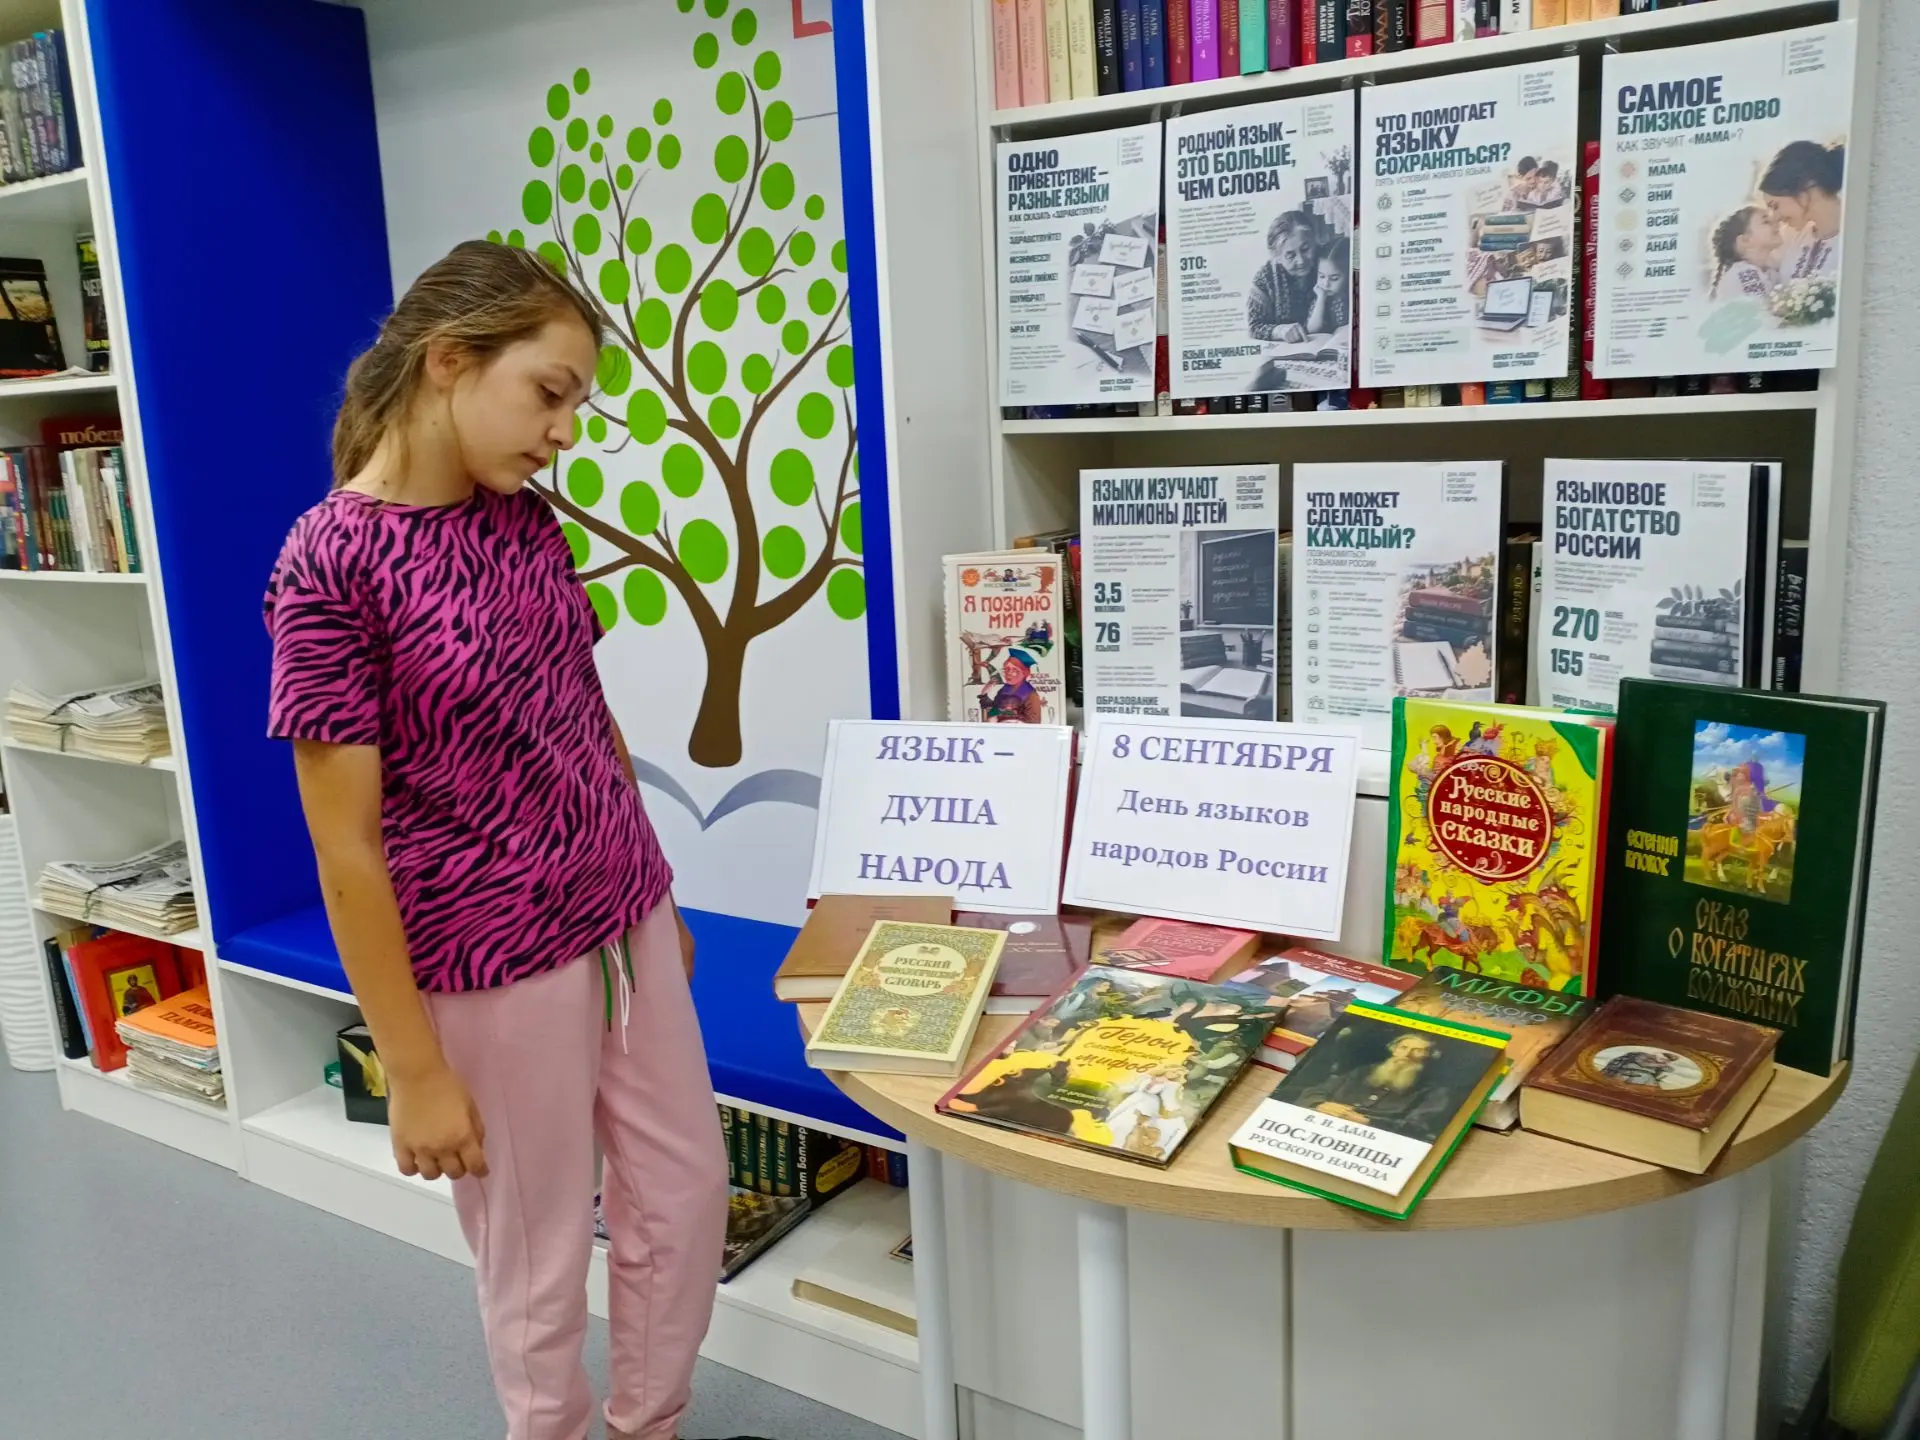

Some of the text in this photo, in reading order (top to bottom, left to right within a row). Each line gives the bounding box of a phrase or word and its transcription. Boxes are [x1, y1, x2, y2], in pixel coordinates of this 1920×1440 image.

[1103, 8, 1113, 57] ПОЦЕЛУЙ
[1618, 75, 1723, 115] САМОЕ
[1375, 101, 1498, 134] ЧТО ПОМОГАЕТ
[1617, 97, 1782, 136] БЛИЗКОЕ СЛОВО
[1177, 124, 1236, 155] РОДНОЙ
[1238, 121, 1284, 147] ЯЗЫК
[1375, 124, 1461, 157] ЯЗЫКУ
[1616, 140, 1640, 152] КАК
[1642, 135, 1686, 150] ЗВУЧИТ
[1008, 149, 1059, 173] ОДНО
[1177, 143, 1296, 179] ЭТО БОЛЬШЕ,
[1374, 142, 1511, 177] СОХРАНЯТЬСЯ?
[1648, 163, 1687, 177] МАМА
[1008, 166, 1097, 192] ПРИВЕТСТВИЕ
[1178, 169, 1281, 201] ЧЕМ СЛОВА
[1008, 182, 1110, 212] РАЗНЫЕ ЯЗЫКИ
[1645, 238, 1678, 252] АНАЙ
[1180, 256, 1207, 271] ЭТО:
[1644, 264, 1676, 278] АННЕ
[1182, 344, 1261, 360] ЯЗЫК НАЧИНАЕТСЯ
[1182, 359, 1222, 371] В СЕМЬЕ
[1092, 479, 1145, 502] ЯЗЫКИ
[1147, 477, 1218, 500] ИЗУЧАЮТ
[1306, 491, 1400, 509] ЧТО МОЖЕТ
[1556, 480, 1666, 506] ЯЗЫКОВОЕ
[1092, 498, 1228, 527] МИЛЛИОНЫ ДЕТЕЙ
[1306, 508, 1384, 528] СДЕЛАТЬ
[1556, 506, 1681, 536] БОГАТСТВО
[1306, 525, 1416, 550] КАЖДЫЙ?
[1555, 532, 1642, 560] РОССИИ
[964, 595, 1051, 613] Я ПОЗНАЮ
[1094, 582, 1122, 605] 3,5
[988, 612, 1025, 629] МИР
[1094, 622, 1121, 643] 76
[1552, 606, 1600, 641] 270
[1551, 648, 1584, 676] 155
[1096, 696, 1158, 706] ОБРАЗОВАНИЕ
[876, 735, 984, 764] ЯЗЫК
[1112, 735, 1336, 774] 8 СЕНТЯБРЯ
[1448, 774, 1532, 809] Русские
[881, 793, 998, 827] ДУША
[1117, 789, 1310, 829] День языков
[1439, 800, 1540, 832] народные
[857, 852, 1012, 890] НАРОДА
[1091, 840, 1329, 885] народов России
[1696, 897, 1750, 941] СКАЗ
[893, 956, 953, 969] РУССКИЙ
[1668, 927, 1809, 994] О БОГАТЫРЯХ
[884, 976, 942, 989] СЛОВАРЬ
[1437, 972, 1585, 1016] МИФЫ
[1440, 991, 1548, 1023] РУССКОГО
[1097, 1026, 1182, 1055] Герои
[1075, 1053, 1158, 1074] мифов
[1257, 1118, 1404, 1171] ПОСЛОВИЦЫ
[1338, 1123, 1378, 1141] ДАЛЬ
[796, 1127, 808, 1169] Батлер
[1248, 1132, 1389, 1182] РУССКОГО НАРОДА
